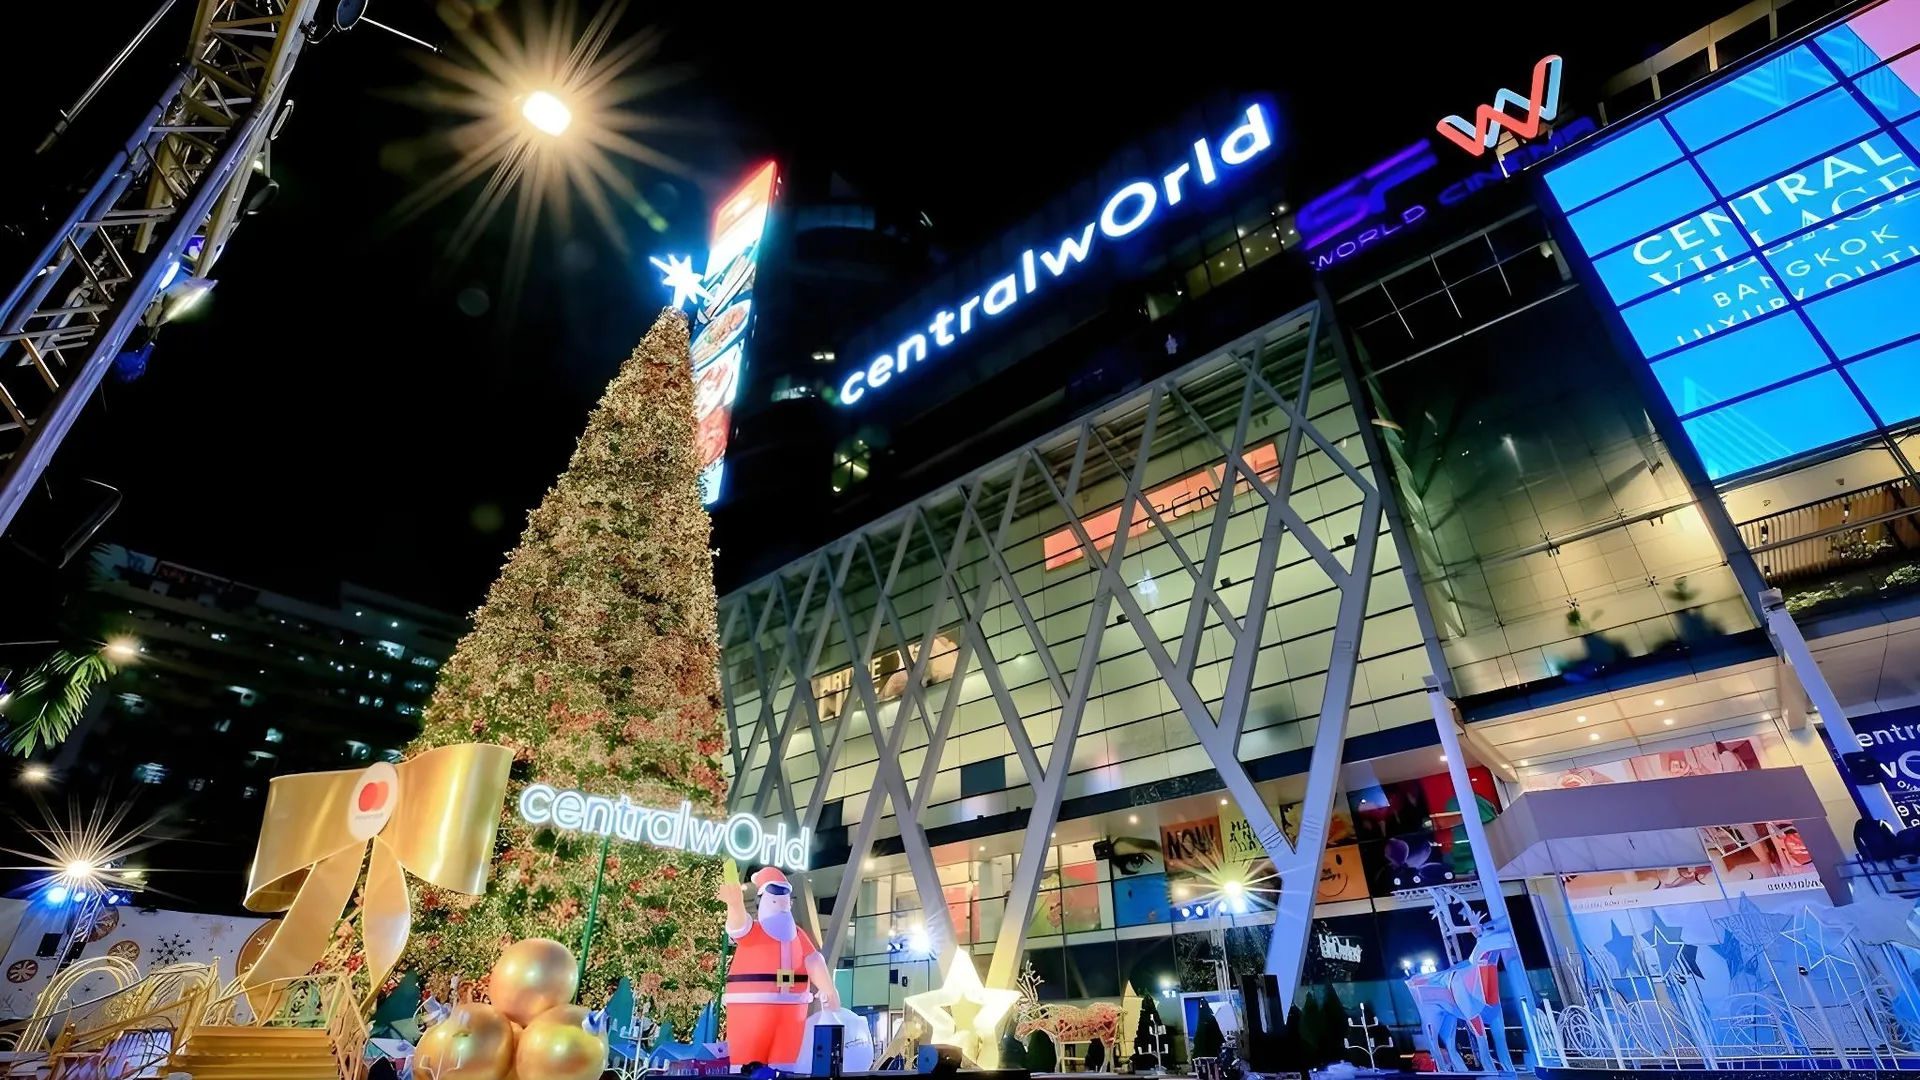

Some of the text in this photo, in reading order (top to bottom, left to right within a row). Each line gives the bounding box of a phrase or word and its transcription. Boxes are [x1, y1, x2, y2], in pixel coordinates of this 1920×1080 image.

[839, 103, 1272, 405] centralwOrld
[1632, 140, 1904, 266] CENTRAL
[1648, 165, 1920, 295] VILLAGE
[1712, 223, 1900, 308] BANGKOK
[519, 783, 811, 870] centralwOrld
